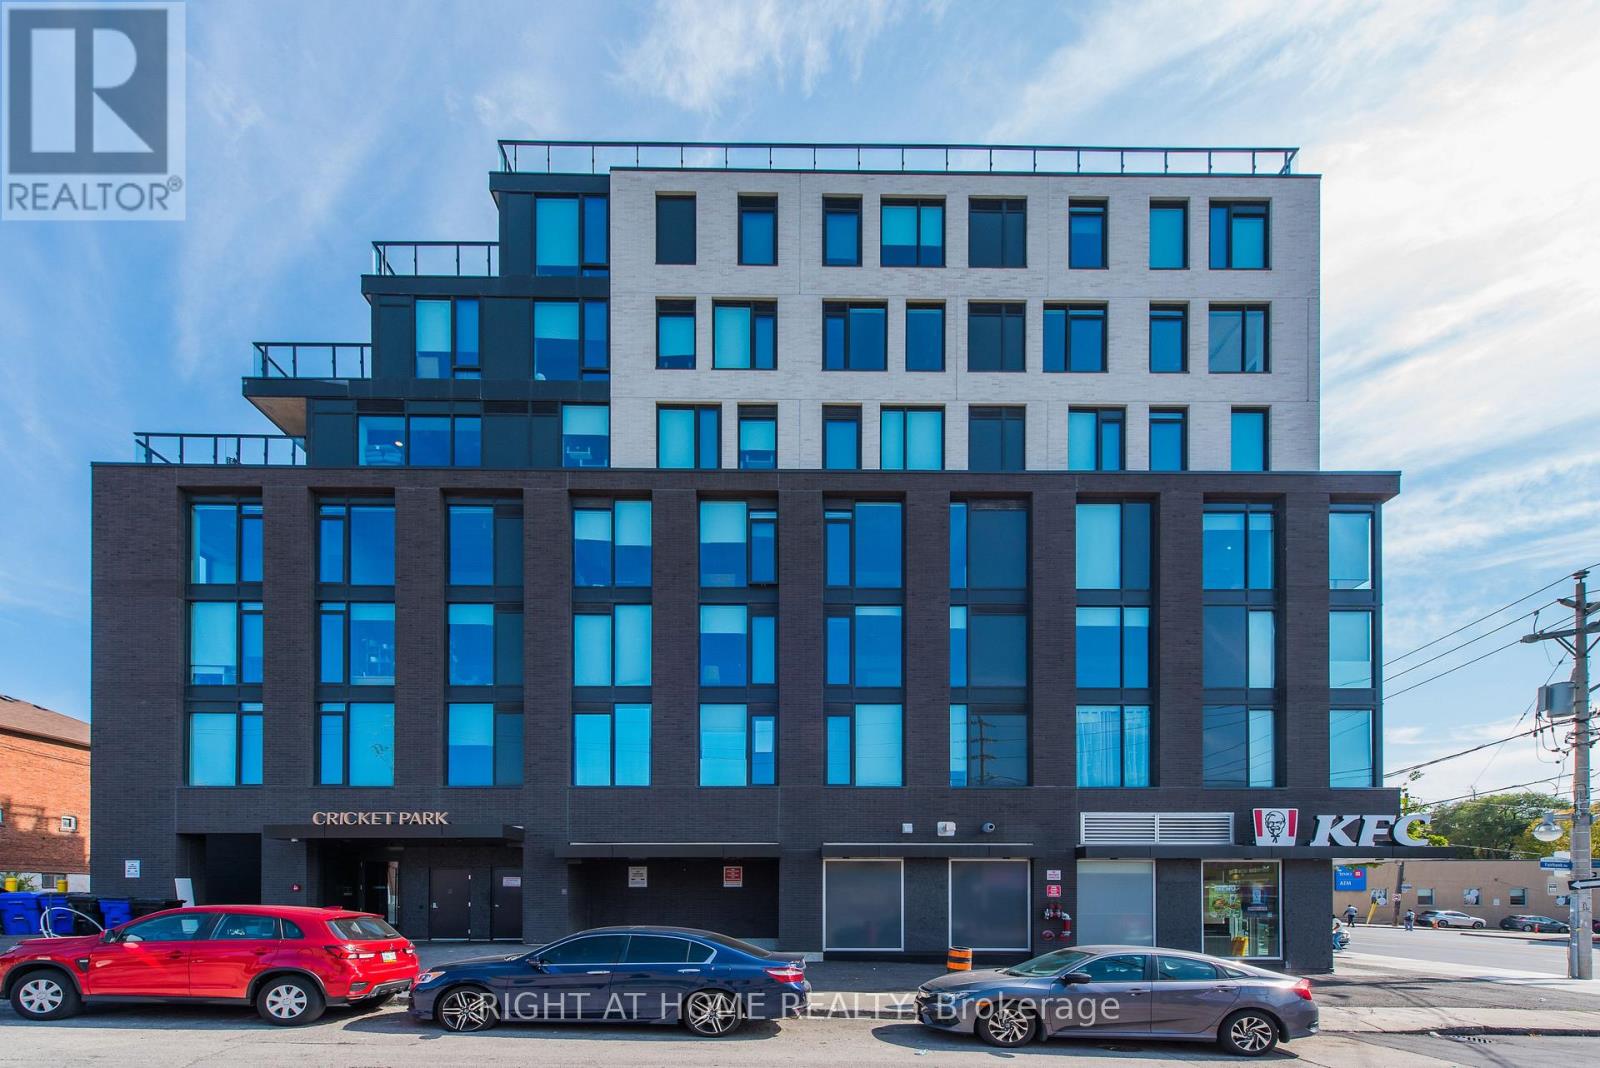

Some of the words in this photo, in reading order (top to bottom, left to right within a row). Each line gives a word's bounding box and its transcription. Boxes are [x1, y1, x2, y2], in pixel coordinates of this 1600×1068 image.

[312, 811, 397, 826] CRICKET
[399, 811, 449, 825] PARK
[1310, 812, 1432, 847] KFC
